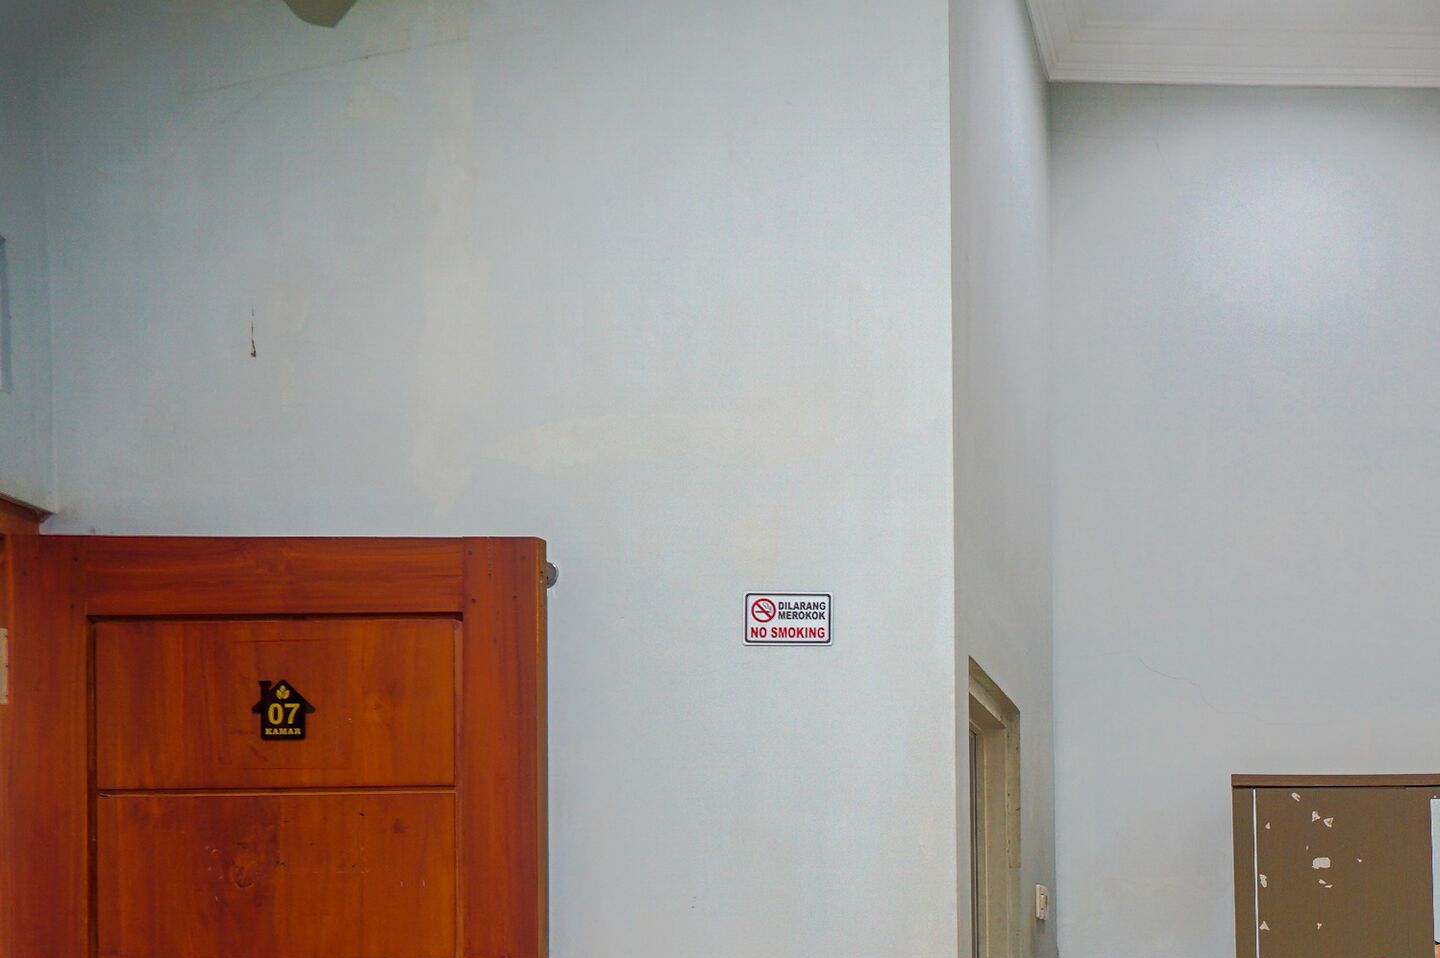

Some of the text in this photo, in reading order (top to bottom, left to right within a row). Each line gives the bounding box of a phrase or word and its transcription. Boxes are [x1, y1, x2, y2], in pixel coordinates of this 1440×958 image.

[778, 601, 826, 611] DILARANG
[778, 611, 826, 620] MEROKOK
[750, 626, 825, 639] NO SMOKING
[268, 703, 300, 725] 07
